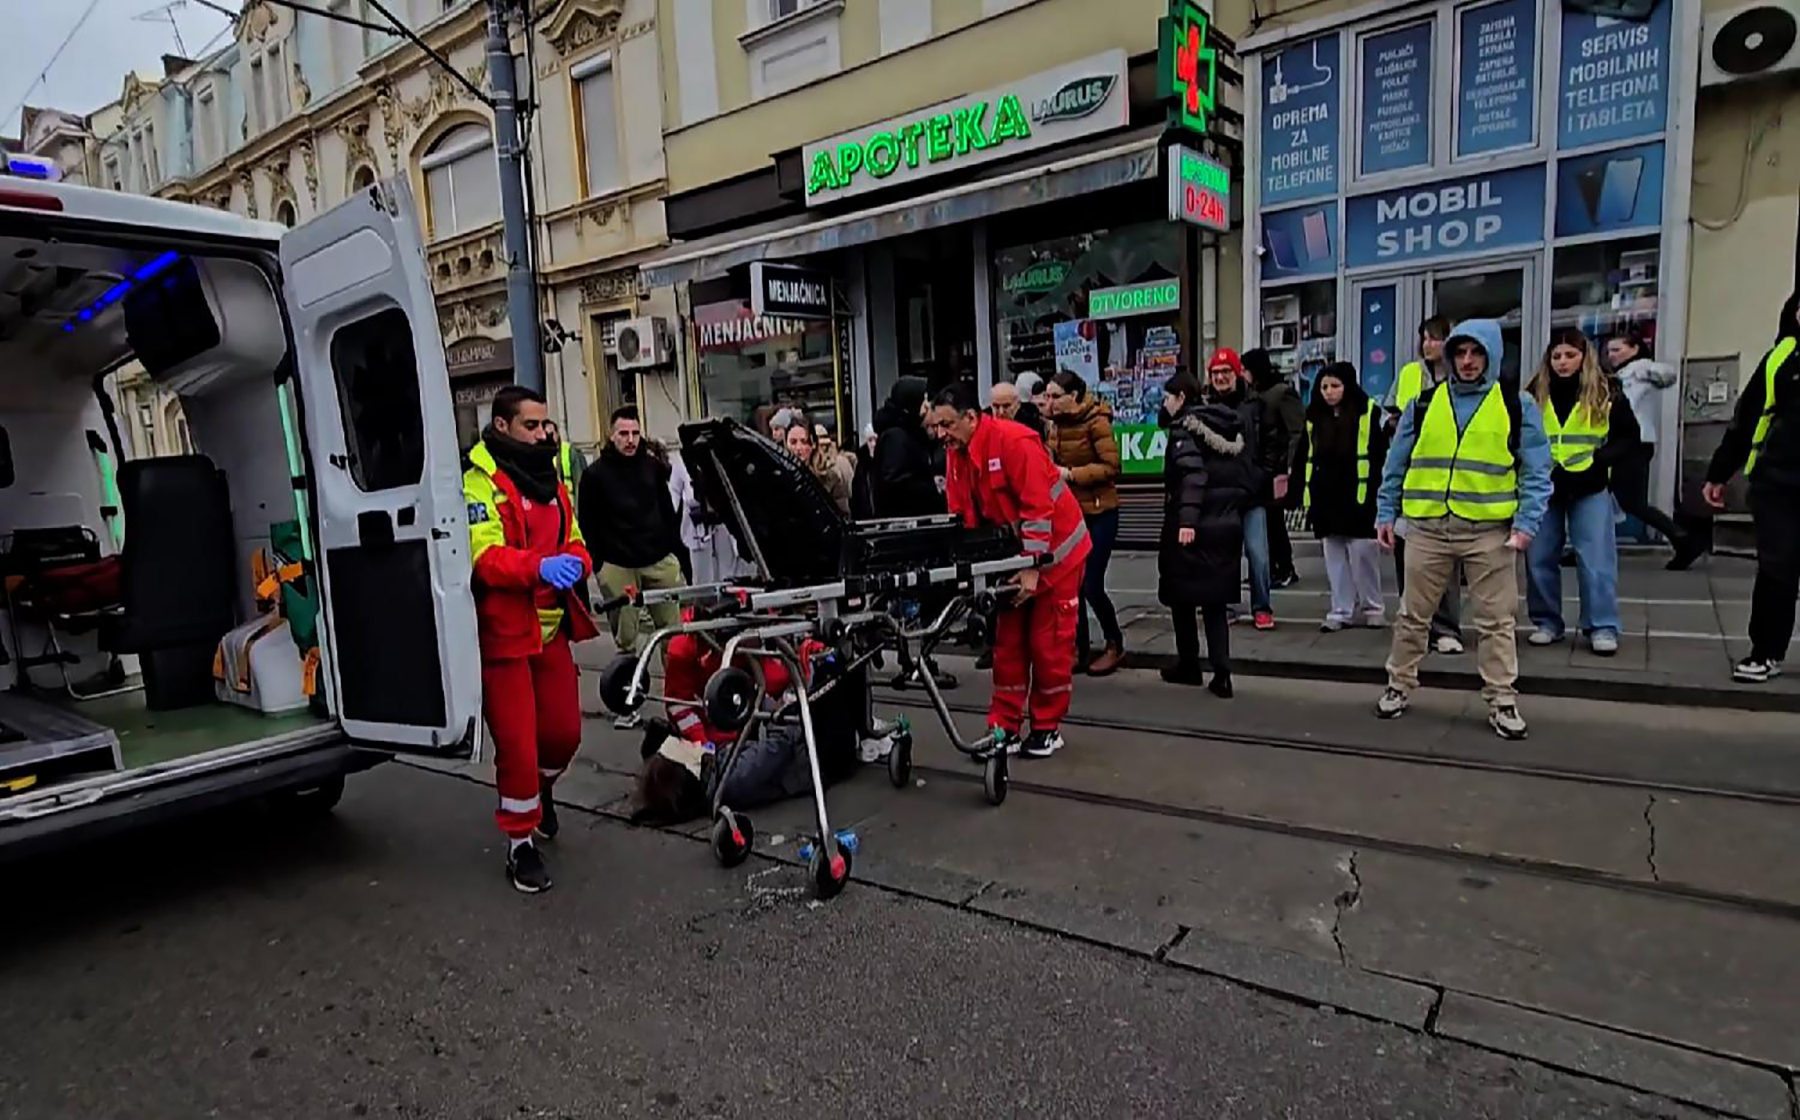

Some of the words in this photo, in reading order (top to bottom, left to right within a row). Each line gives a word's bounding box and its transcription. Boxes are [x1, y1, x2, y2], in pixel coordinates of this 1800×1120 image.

[1581, 25, 1649, 57] SERVIS
[1569, 47, 1659, 85] MOBILNIH
[1565, 73, 1659, 109] TELEFONA
[1273, 103, 1328, 130] OPREMA
[1567, 115, 1573, 133] I
[1578, 99, 1655, 131] TABLETA
[808, 94, 1031, 196] APOTEKA
[1032, 81, 1104, 121] LAURUS
[1291, 129, 1308, 147] ZA
[1272, 145, 1330, 171] MOBILNE
[1267, 165, 1333, 192] TELEFONE
[1377, 181, 1502, 224] MOBIL
[1377, 215, 1502, 256] SHOP
[769, 279, 827, 305] MENJAČNICA
[1091, 284, 1177, 314] OTVORENO
[1115, 431, 1168, 460] KA
